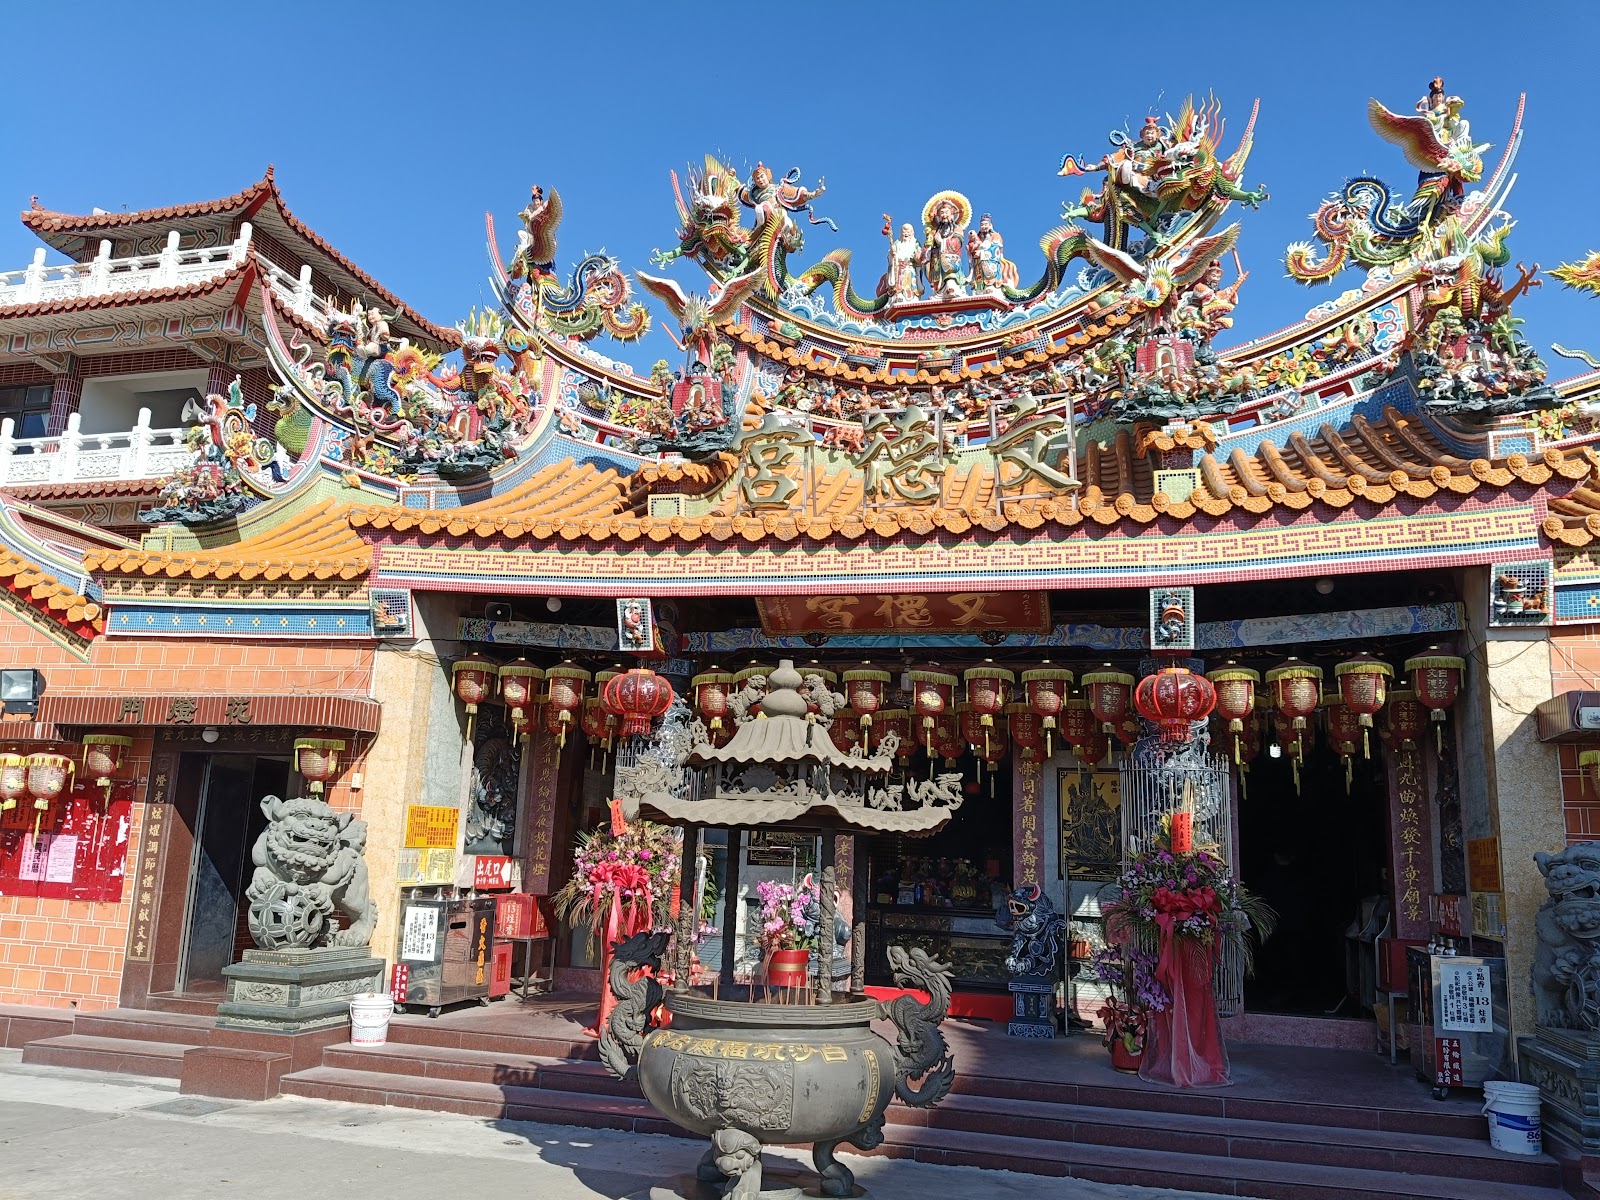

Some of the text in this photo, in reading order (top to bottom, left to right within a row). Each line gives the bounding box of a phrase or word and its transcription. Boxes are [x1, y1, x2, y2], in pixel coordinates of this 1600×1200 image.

[731, 396, 1082, 508] 文德宮
[804, 592, 1008, 628] 文德宮
[118, 697, 253, 723] 花燈門
[476, 860, 500, 877] 出虎口
